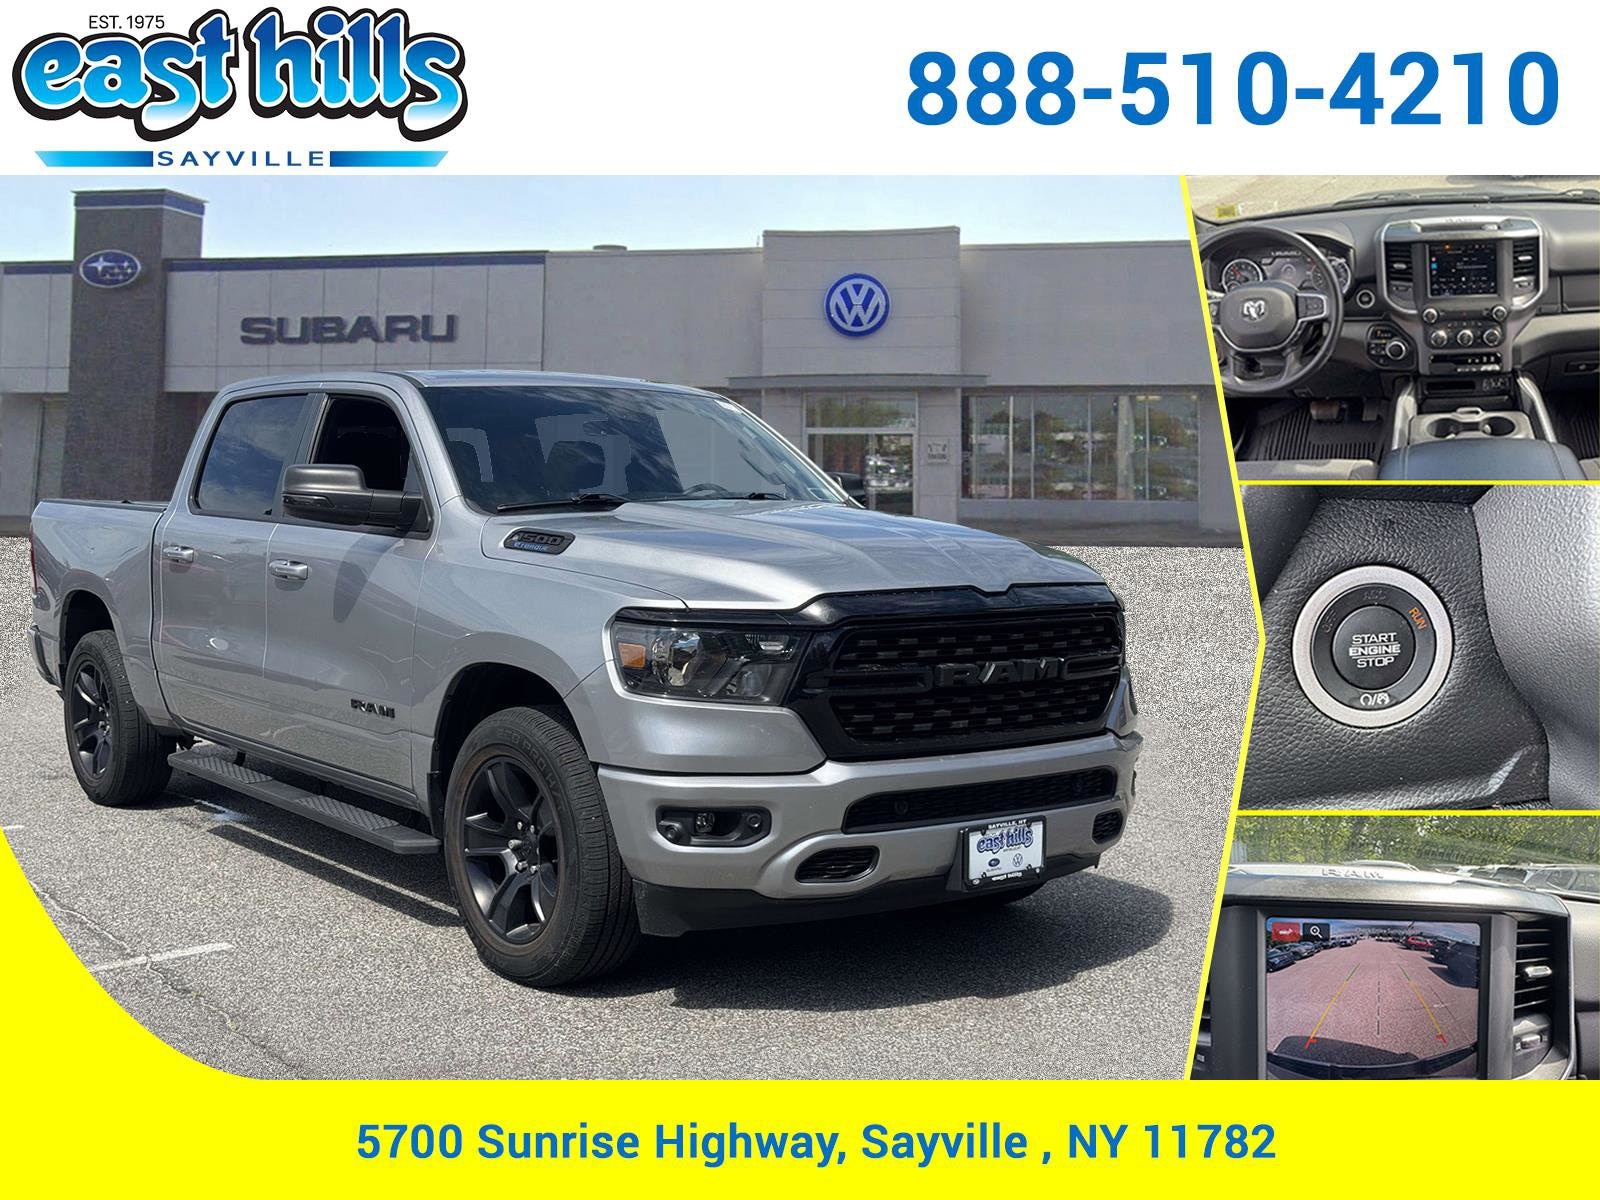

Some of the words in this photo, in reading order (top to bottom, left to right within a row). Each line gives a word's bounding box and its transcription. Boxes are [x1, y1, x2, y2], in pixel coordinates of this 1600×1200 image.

[240, 314, 457, 345] SUBARU
[1408, 606, 1427, 630] RUN
[1352, 633, 1397, 644] START
[1349, 643, 1401, 657] ENGINE
[934, 656, 1065, 688] RAM
[1356, 656, 1395, 669] STOP
[350, 698, 396, 719] RAM
[977, 832, 1005, 854] east
[1006, 827, 1033, 848] hills
